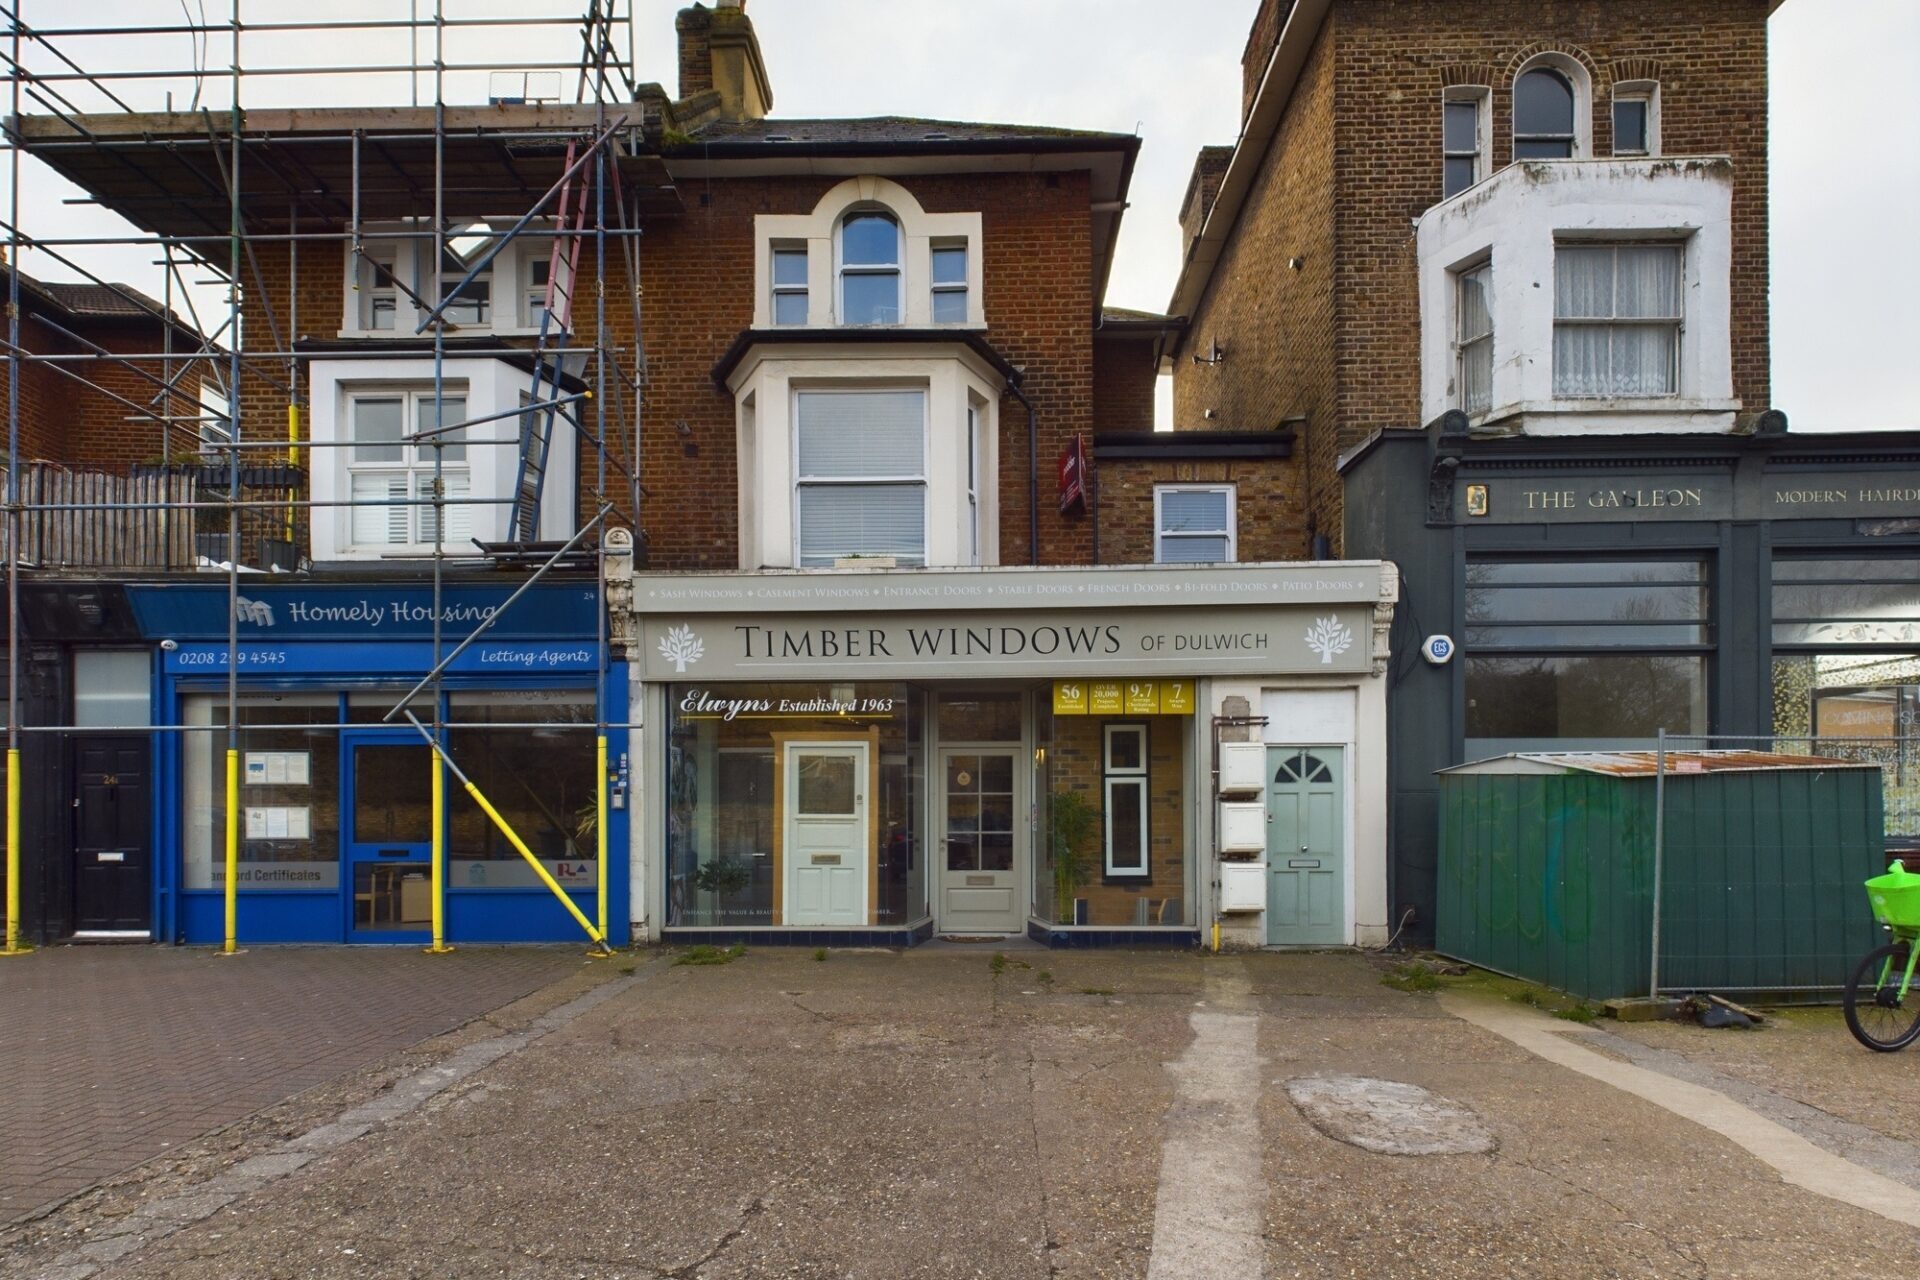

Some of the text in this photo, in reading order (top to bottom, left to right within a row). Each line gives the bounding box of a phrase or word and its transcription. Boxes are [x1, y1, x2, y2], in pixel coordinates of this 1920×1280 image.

[1523, 489, 1702, 509] THE GALEON
[1776, 489, 1920, 504] MODERN HAIRD
[583, 592, 595, 600] 24
[659, 581, 1353, 599] SASH WINDOWS CASEMENT WINDOWS ENTRANCE DOORS STABLE DOORS FRENCH DOORS BI-FOLD DOORS PATIO DOORS
[288, 601, 384, 626] Homely
[734, 625, 1268, 657] TIMBER WINDOWS OF DULWICH
[1434, 642, 1447, 653] ECS
[179, 651, 286, 664] 0208 29 4545
[481, 650, 592, 666] Letting Agents
[1061, 684, 1080, 699] 56
[1094, 690, 1119, 698] 20,000
[1130, 683, 1153, 698] 9.7
[1172, 684, 1182, 699] 7
[680, 689, 893, 721] Elwyns Established 1963
[254, 869, 321, 881] Certificates
